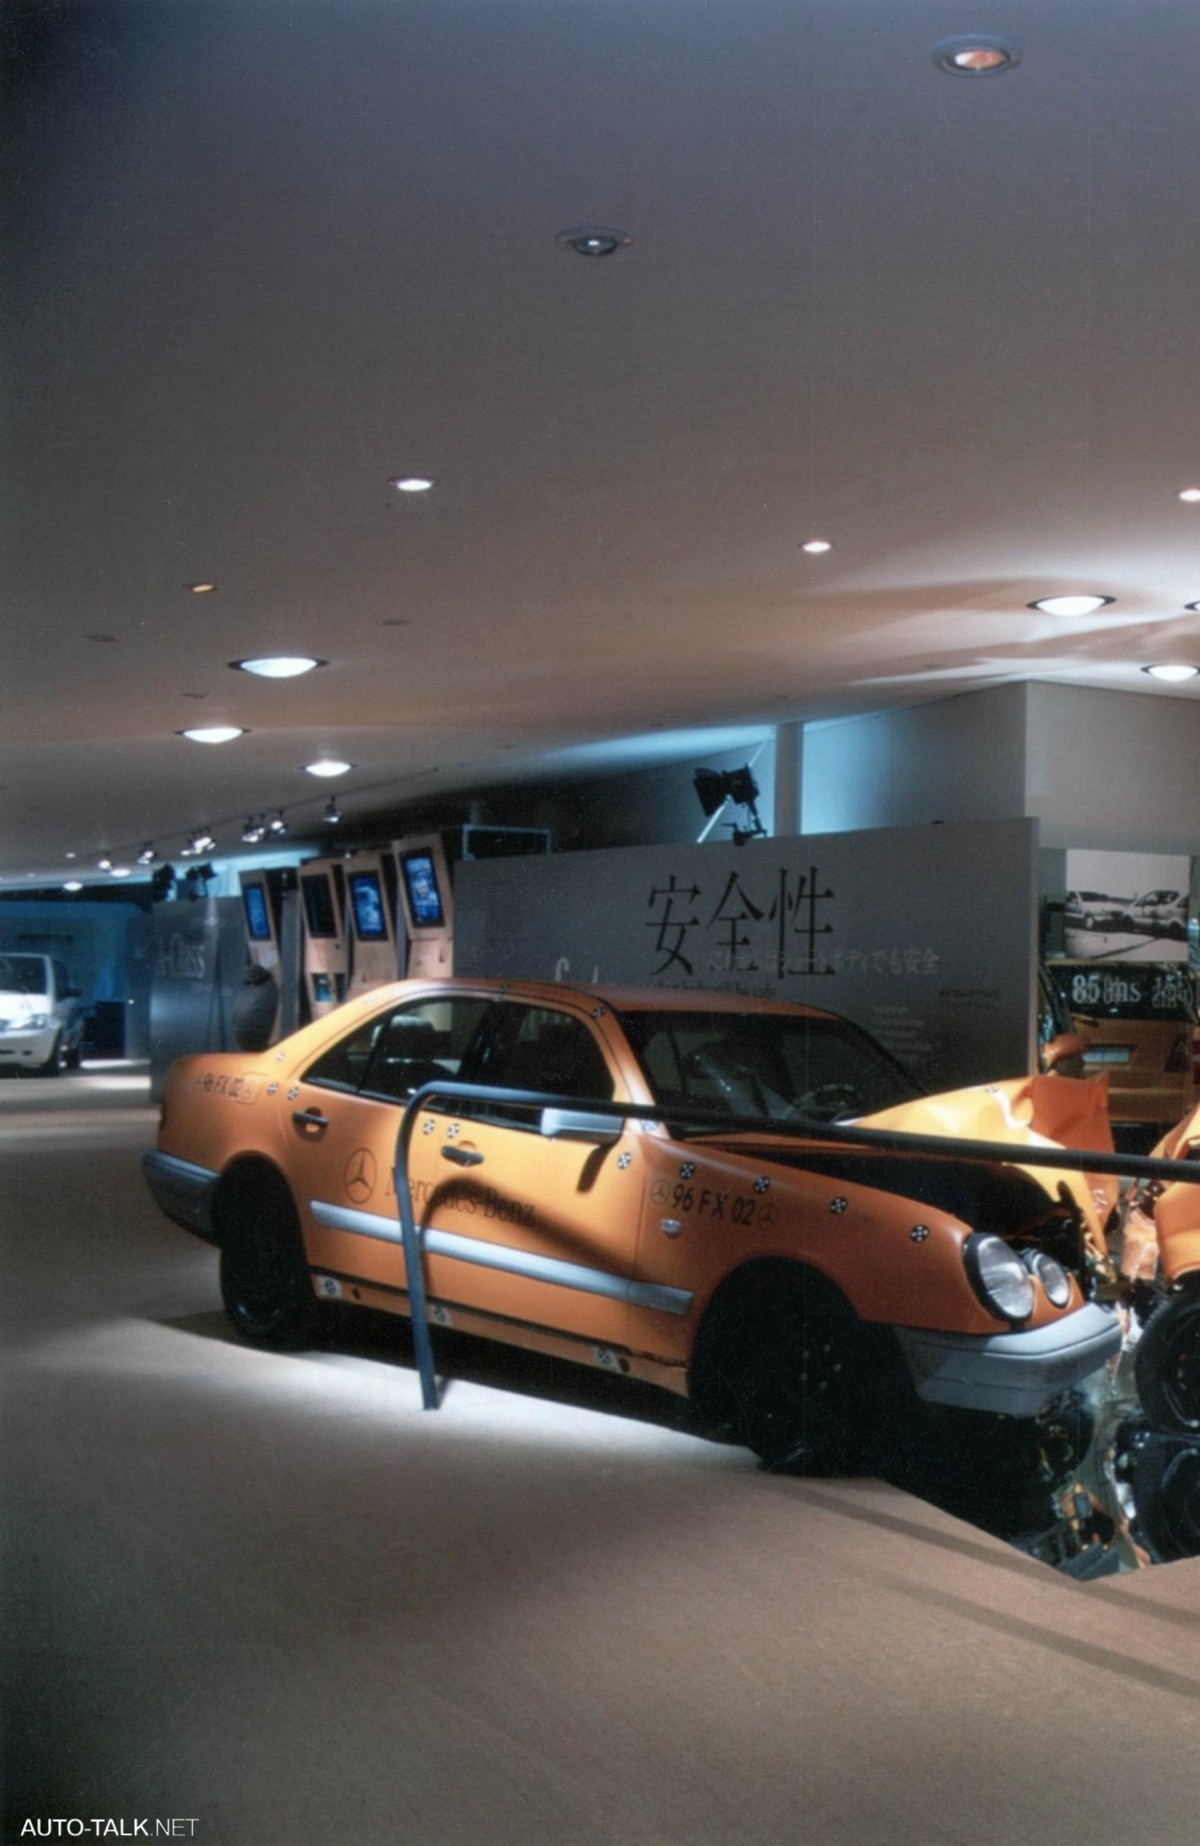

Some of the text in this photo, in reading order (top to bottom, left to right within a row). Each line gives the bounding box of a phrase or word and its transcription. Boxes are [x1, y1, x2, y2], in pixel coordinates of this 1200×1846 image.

[645, 866, 837, 980] 安全性
[672, 1183, 756, 1226] 96 FX 02
